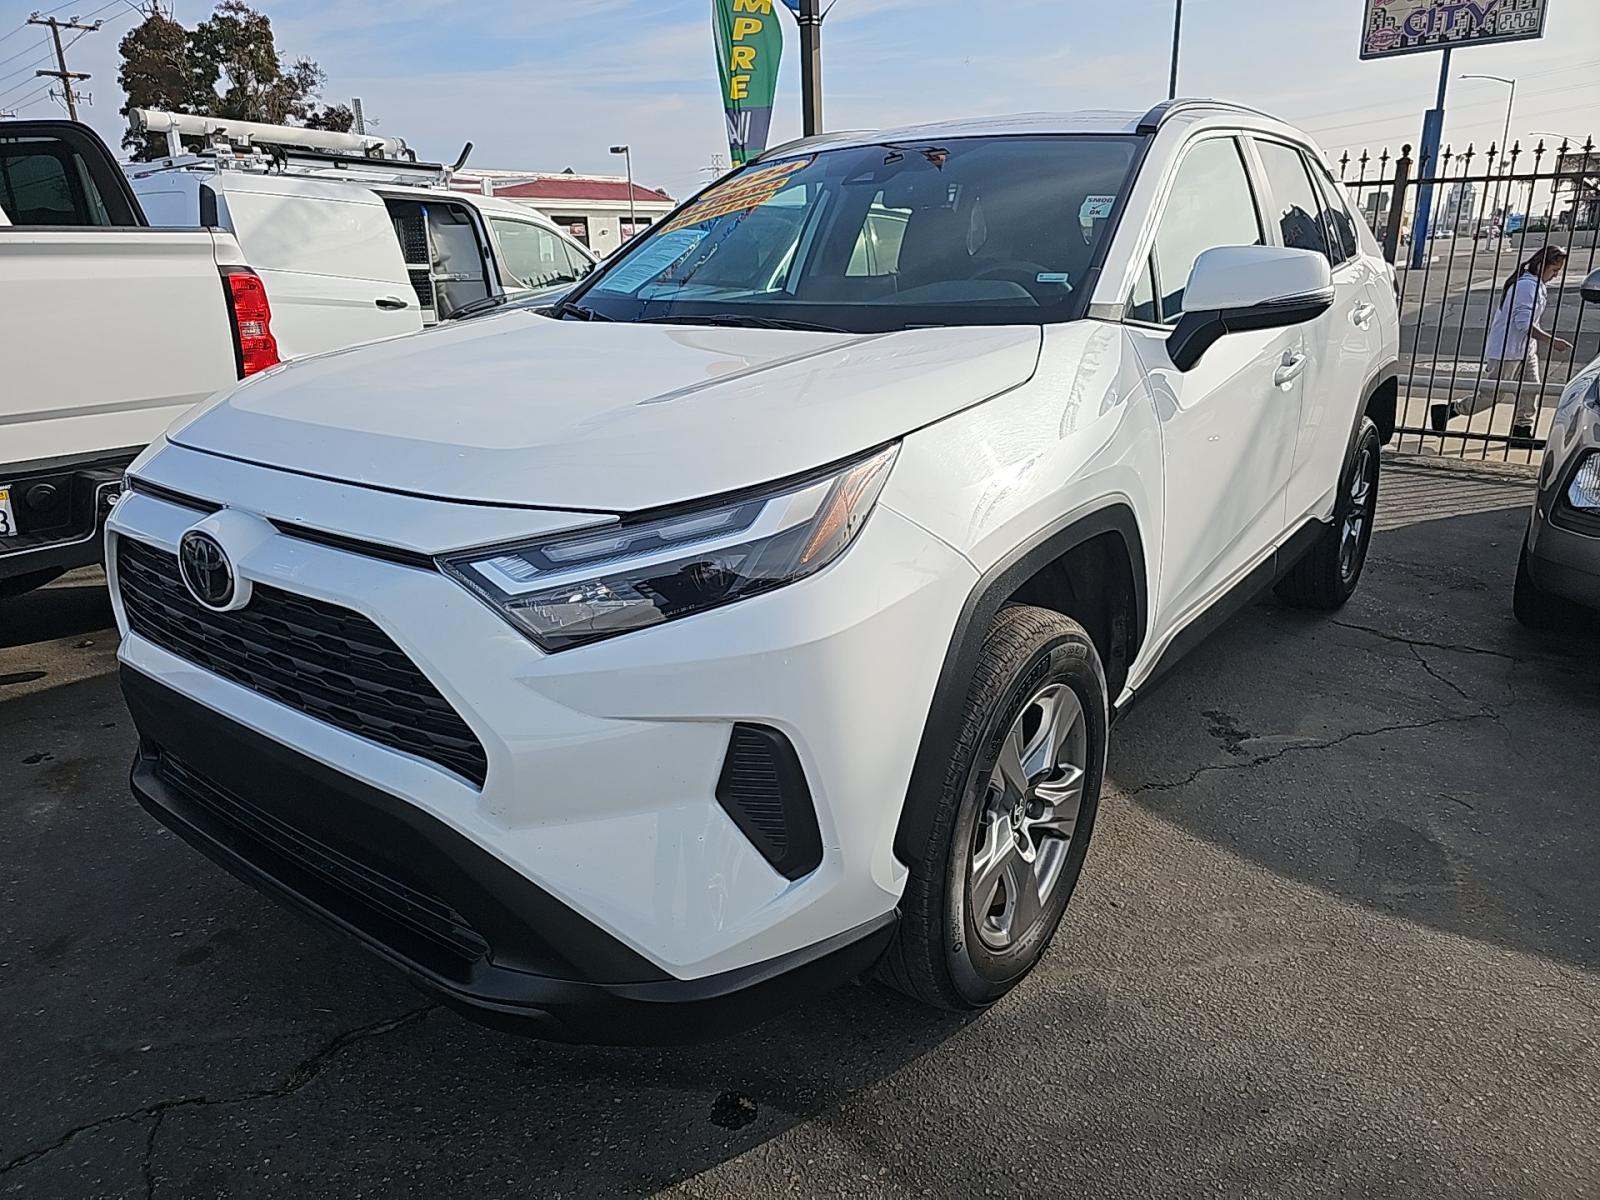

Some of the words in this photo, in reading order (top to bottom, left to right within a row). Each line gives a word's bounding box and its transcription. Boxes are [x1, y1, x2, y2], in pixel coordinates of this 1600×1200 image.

[1403, 0, 1501, 37] CITY
[1504, 12, 1533, 23] PRO
[1500, 18, 1536, 30] CLUB
